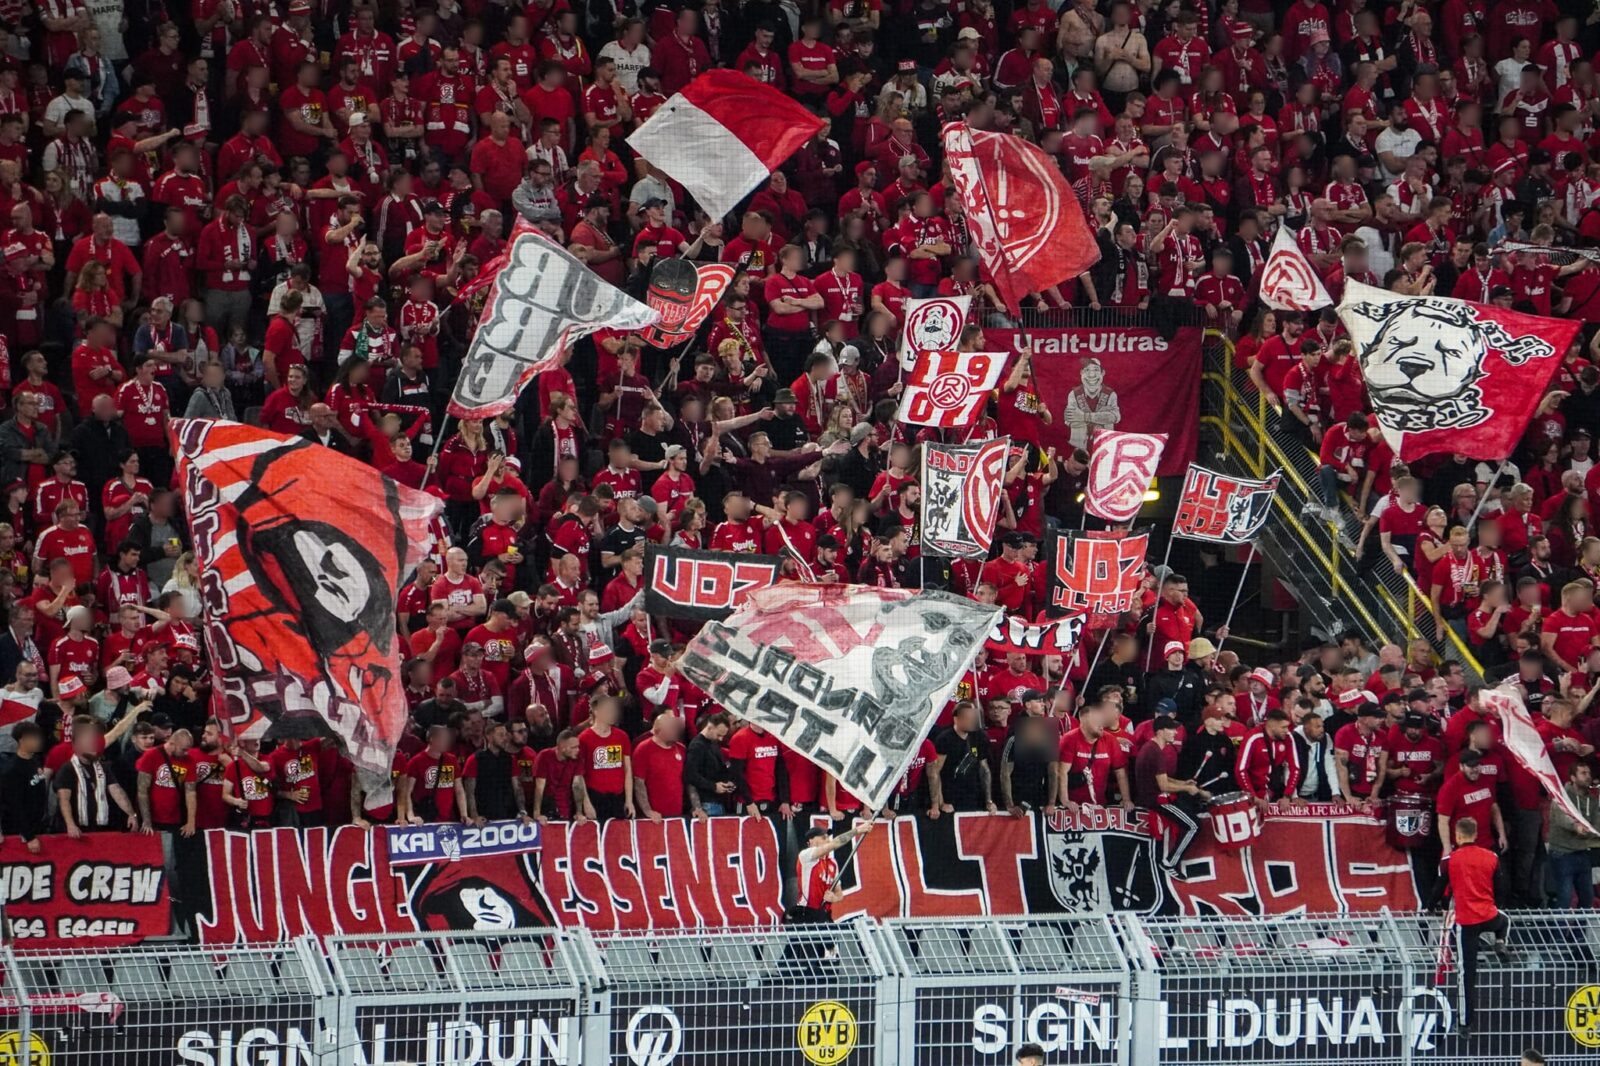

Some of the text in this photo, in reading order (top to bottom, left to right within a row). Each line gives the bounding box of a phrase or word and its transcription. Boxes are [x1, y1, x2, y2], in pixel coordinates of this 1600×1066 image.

[1013, 332, 1169, 354] Uralt-Ultras
[652, 554, 775, 609] UDZ
[1056, 533, 1149, 594] UDZ
[390, 822, 538, 853] KAI 2000
[69, 864, 162, 902] CREW
[541, 816, 785, 938] ESSENER
[806, 1009, 848, 1046] BVB
[1207, 997, 1386, 1048] IDUNA
[818, 1045, 836, 1058] 09
